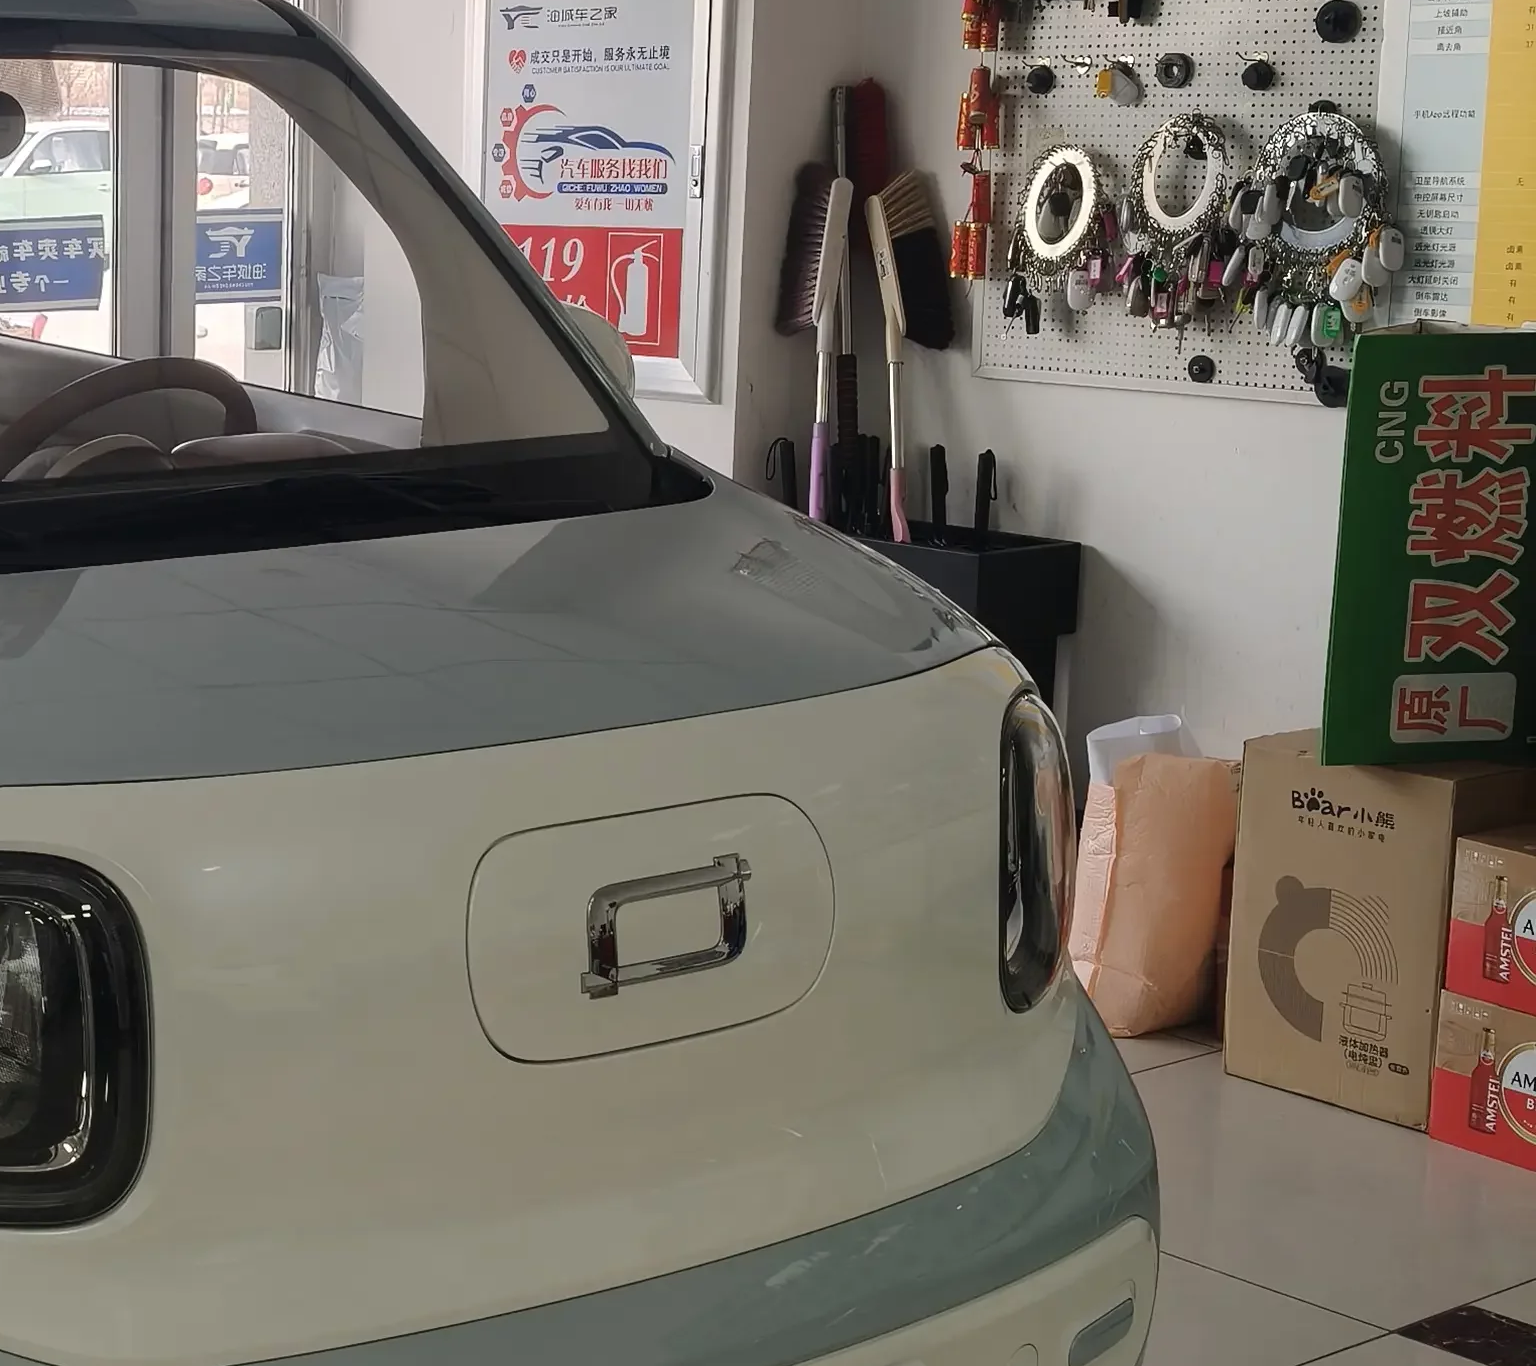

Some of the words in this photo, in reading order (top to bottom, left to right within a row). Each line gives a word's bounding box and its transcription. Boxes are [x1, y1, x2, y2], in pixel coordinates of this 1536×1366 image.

[547, 6, 618, 23] 油城车之家
[560, 158, 667, 179] 汽车服务找我们
[586, 184, 607, 193] FUWU
[610, 184, 631, 193] ZHAO
[634, 184, 662, 193] WOMEN
[1375, 380, 1410, 464] CNG
[1404, 365, 1536, 665] 双燃料
